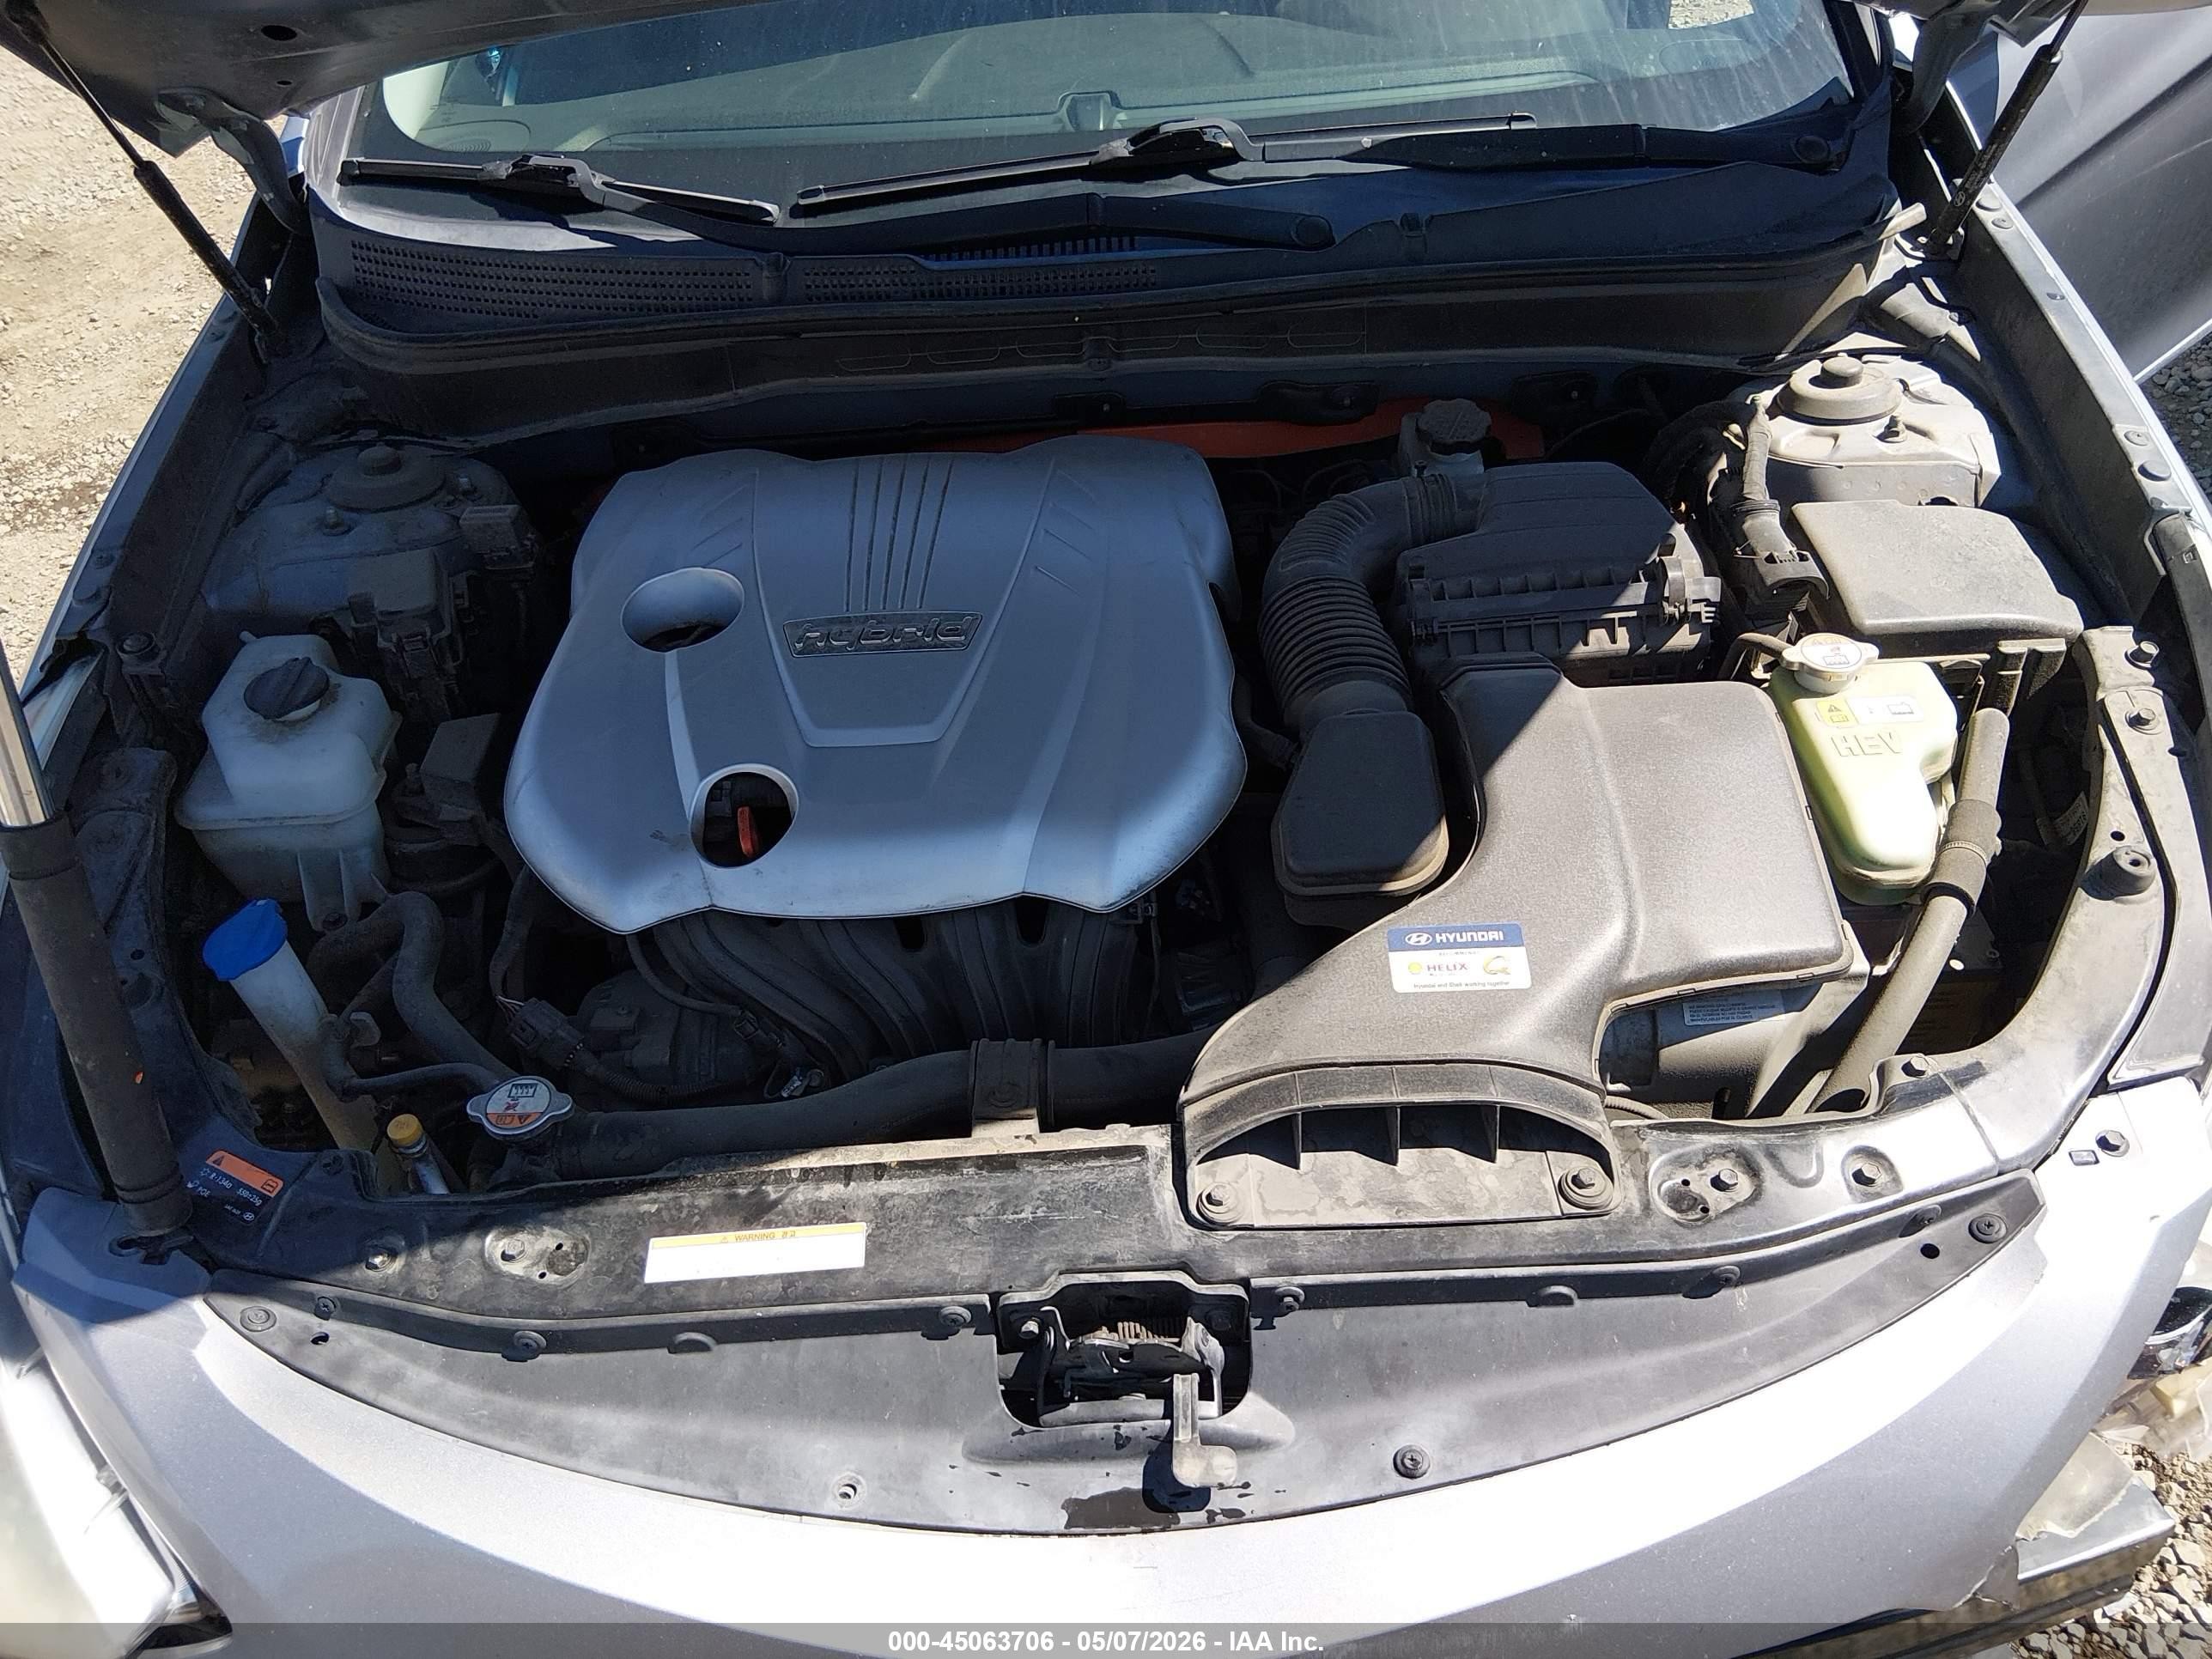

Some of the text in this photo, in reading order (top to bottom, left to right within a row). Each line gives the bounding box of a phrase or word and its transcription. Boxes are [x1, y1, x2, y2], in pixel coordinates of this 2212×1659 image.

[795, 617, 975, 650] hybrid
[1831, 732, 1902, 757] HEV
[1436, 931, 1504, 944] HYUNDAI
[1426, 962, 1468, 972] HELIX
[734, 1231, 775, 1243] WARNING
